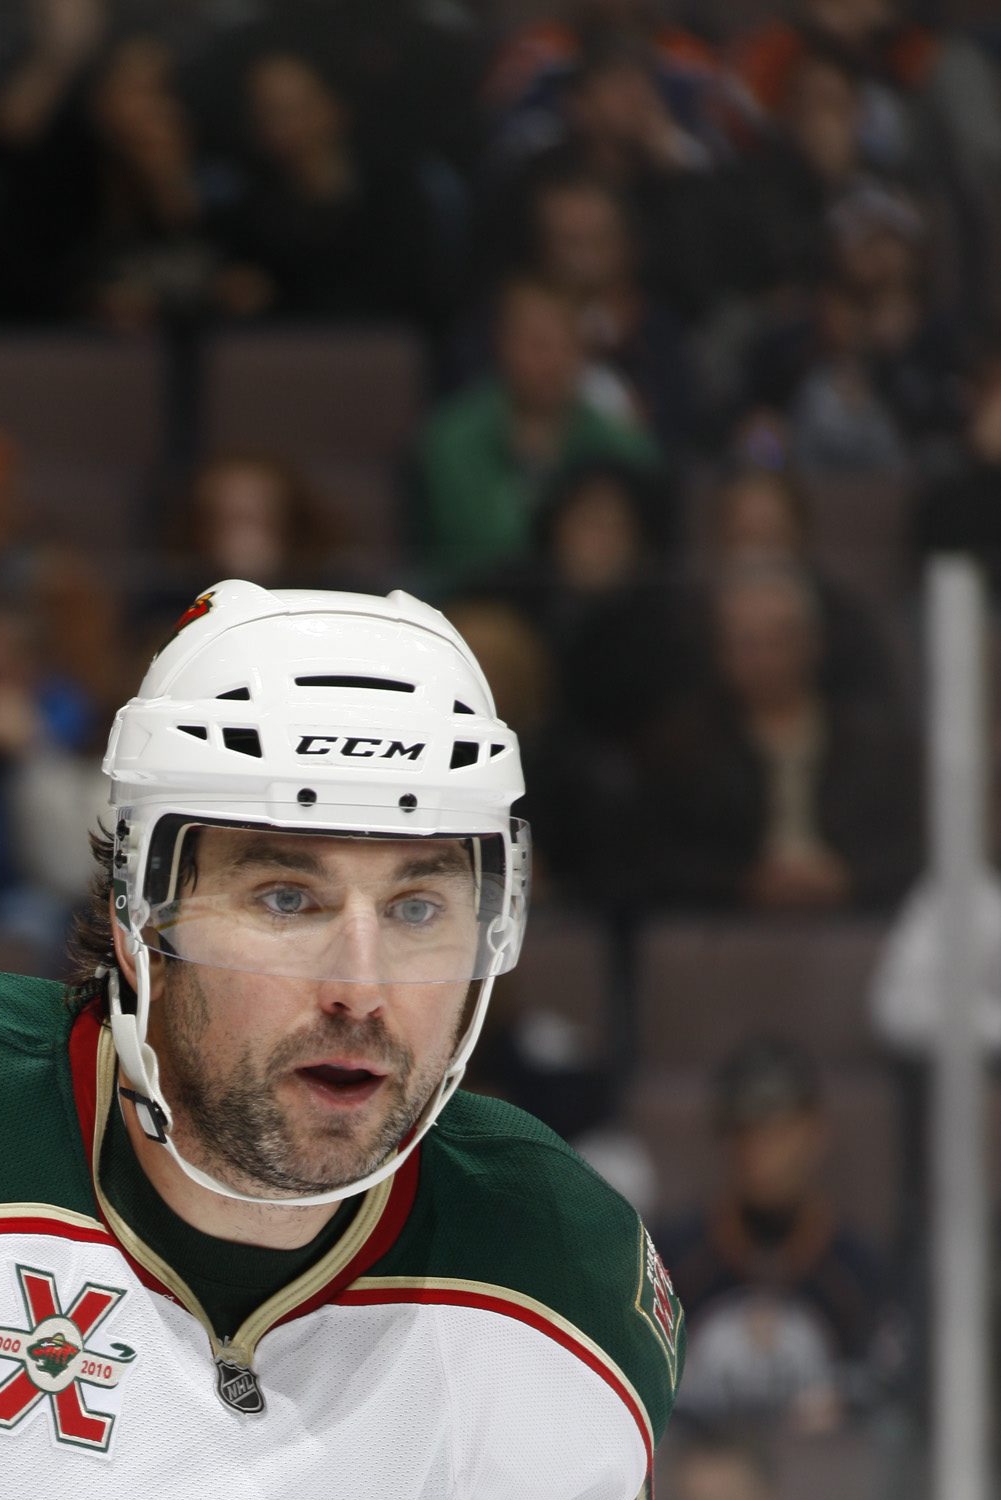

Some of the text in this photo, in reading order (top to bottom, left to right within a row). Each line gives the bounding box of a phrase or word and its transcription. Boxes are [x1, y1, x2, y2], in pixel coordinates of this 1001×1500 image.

[295, 735, 426, 760] CCM
[80, 1360, 113, 1379] 2010
[226, 1375, 255, 1400] NHL
